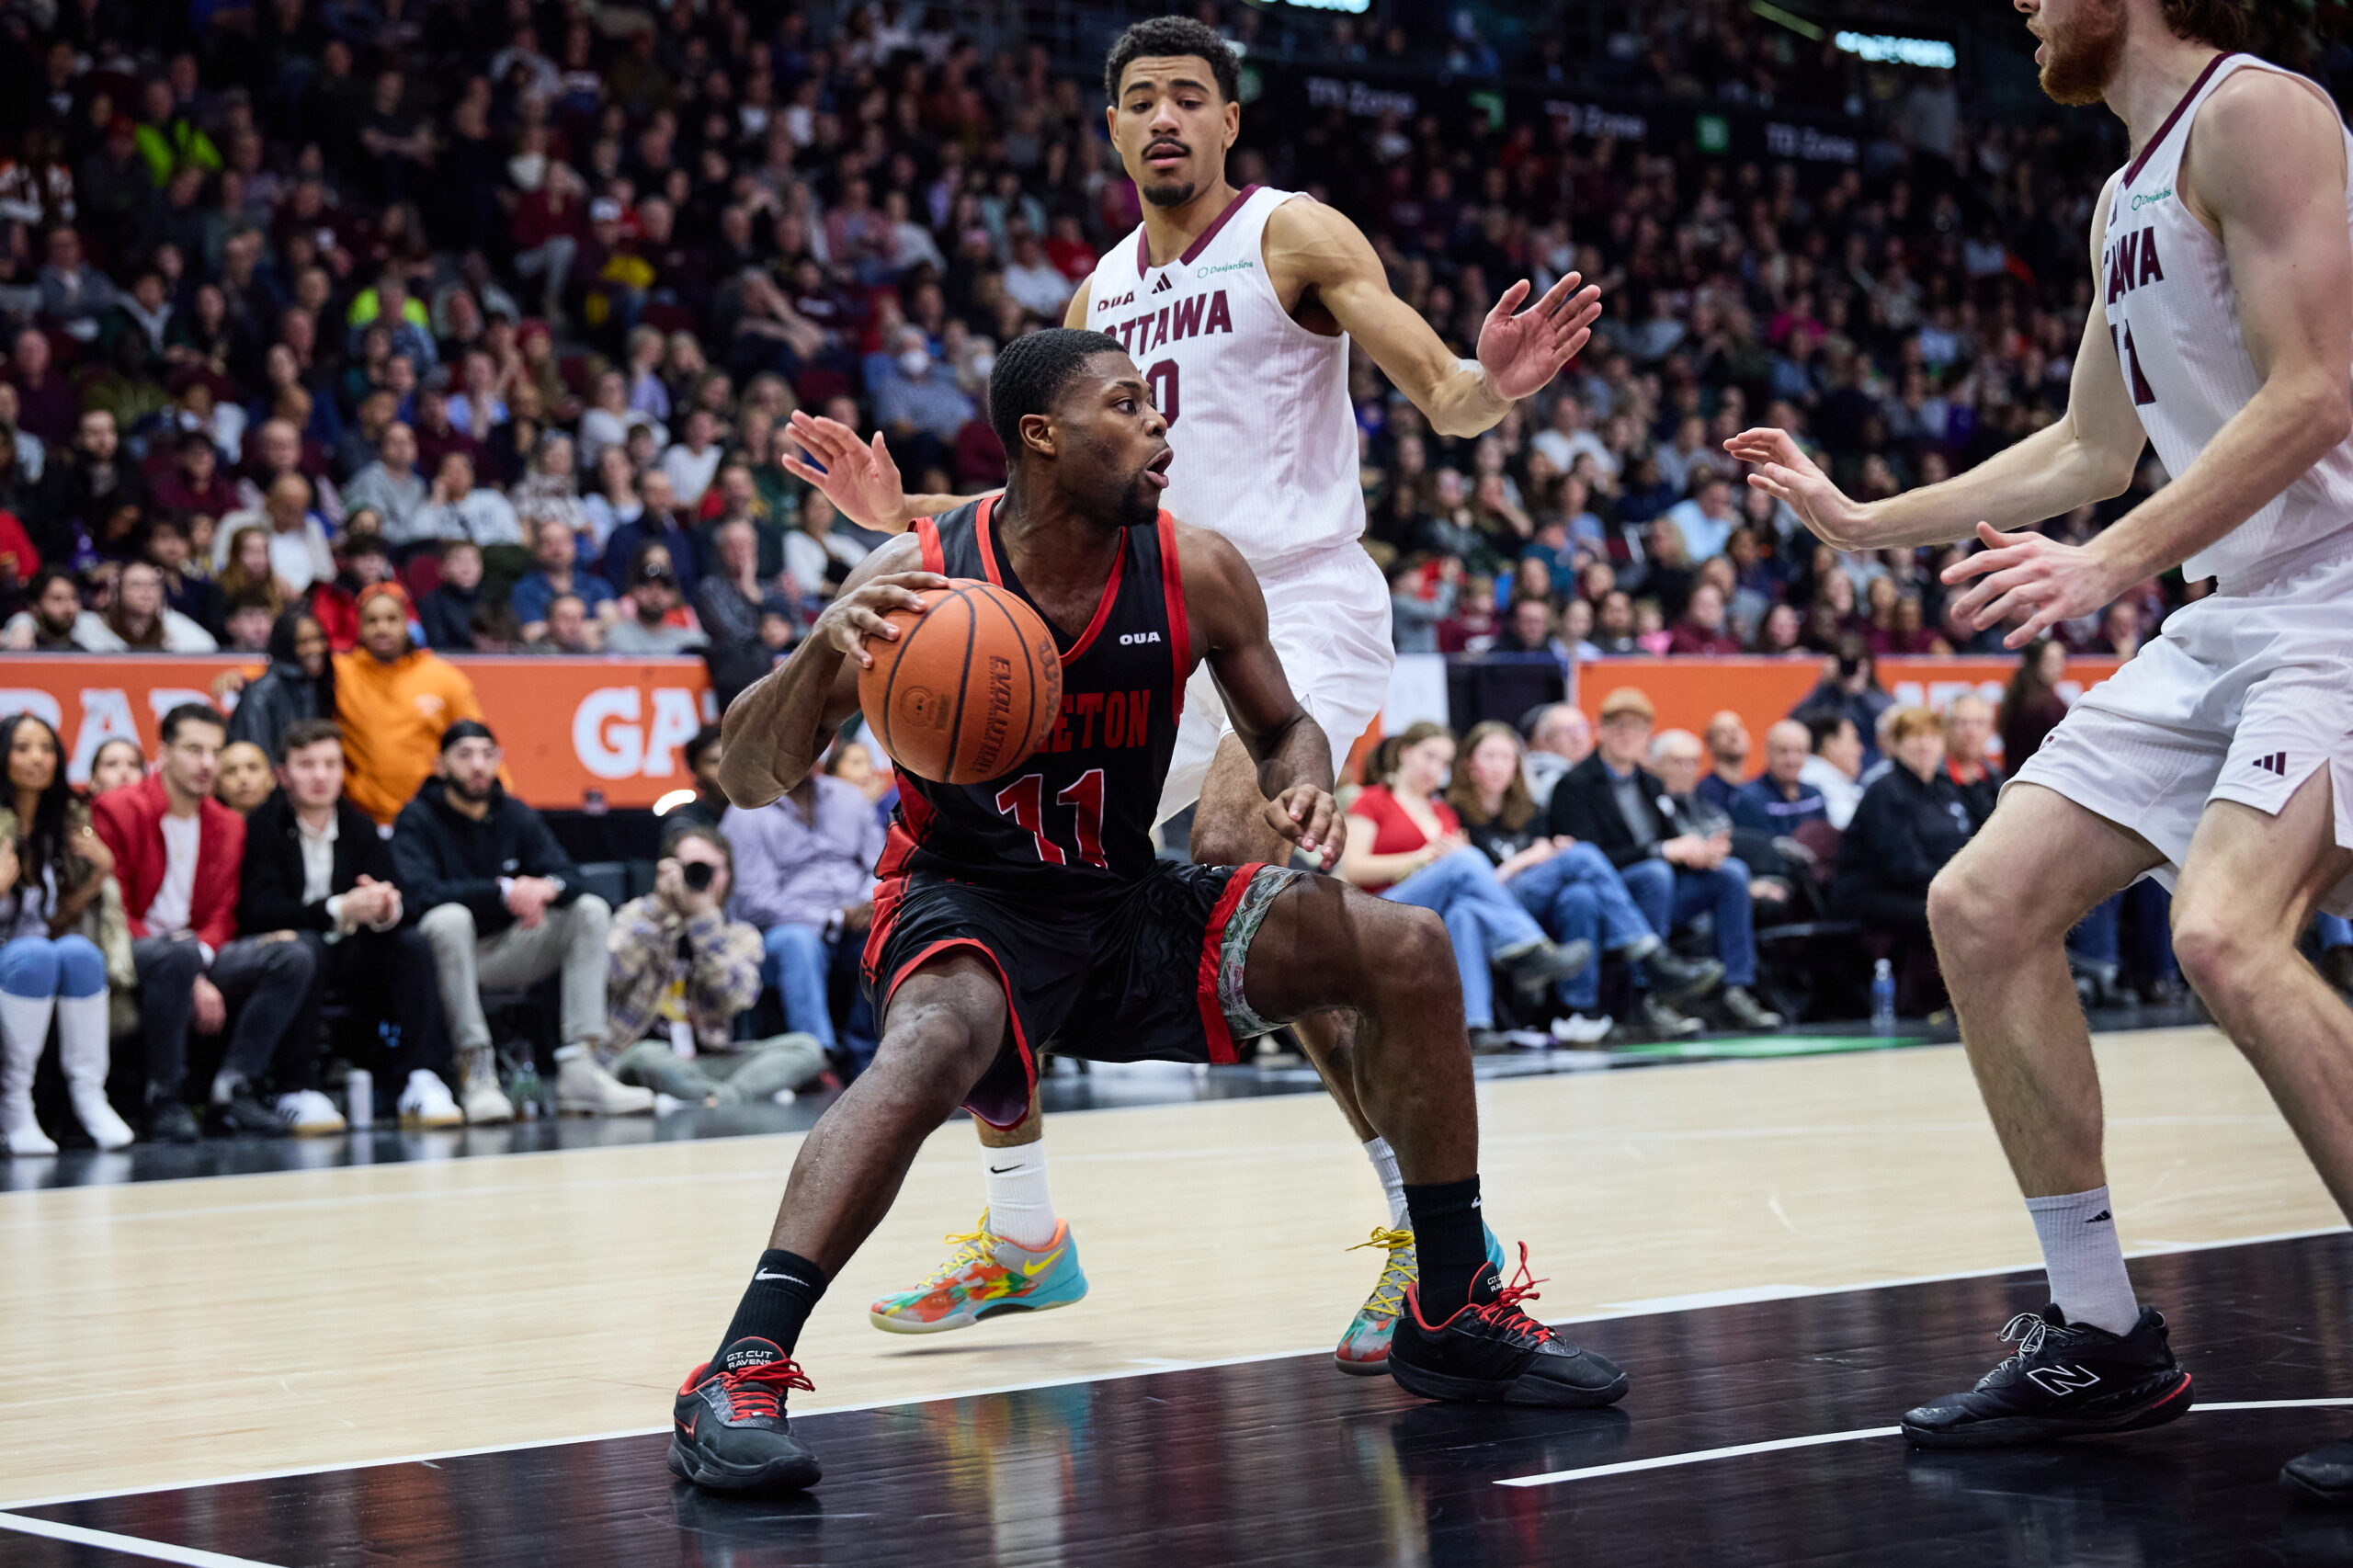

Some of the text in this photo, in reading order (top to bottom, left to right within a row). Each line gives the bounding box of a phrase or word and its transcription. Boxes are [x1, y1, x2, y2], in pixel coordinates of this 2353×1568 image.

[1802, 127, 1857, 162] Zone
[1210, 260, 1254, 276] Desjardins
[2102, 226, 2164, 309] AWA
[1120, 631, 1161, 645] OUA
[572, 687, 720, 779] GA
[976, 656, 1011, 775] EVOLUTION
[995, 768, 1108, 869] 11
[745, 1350, 773, 1358] CUT
